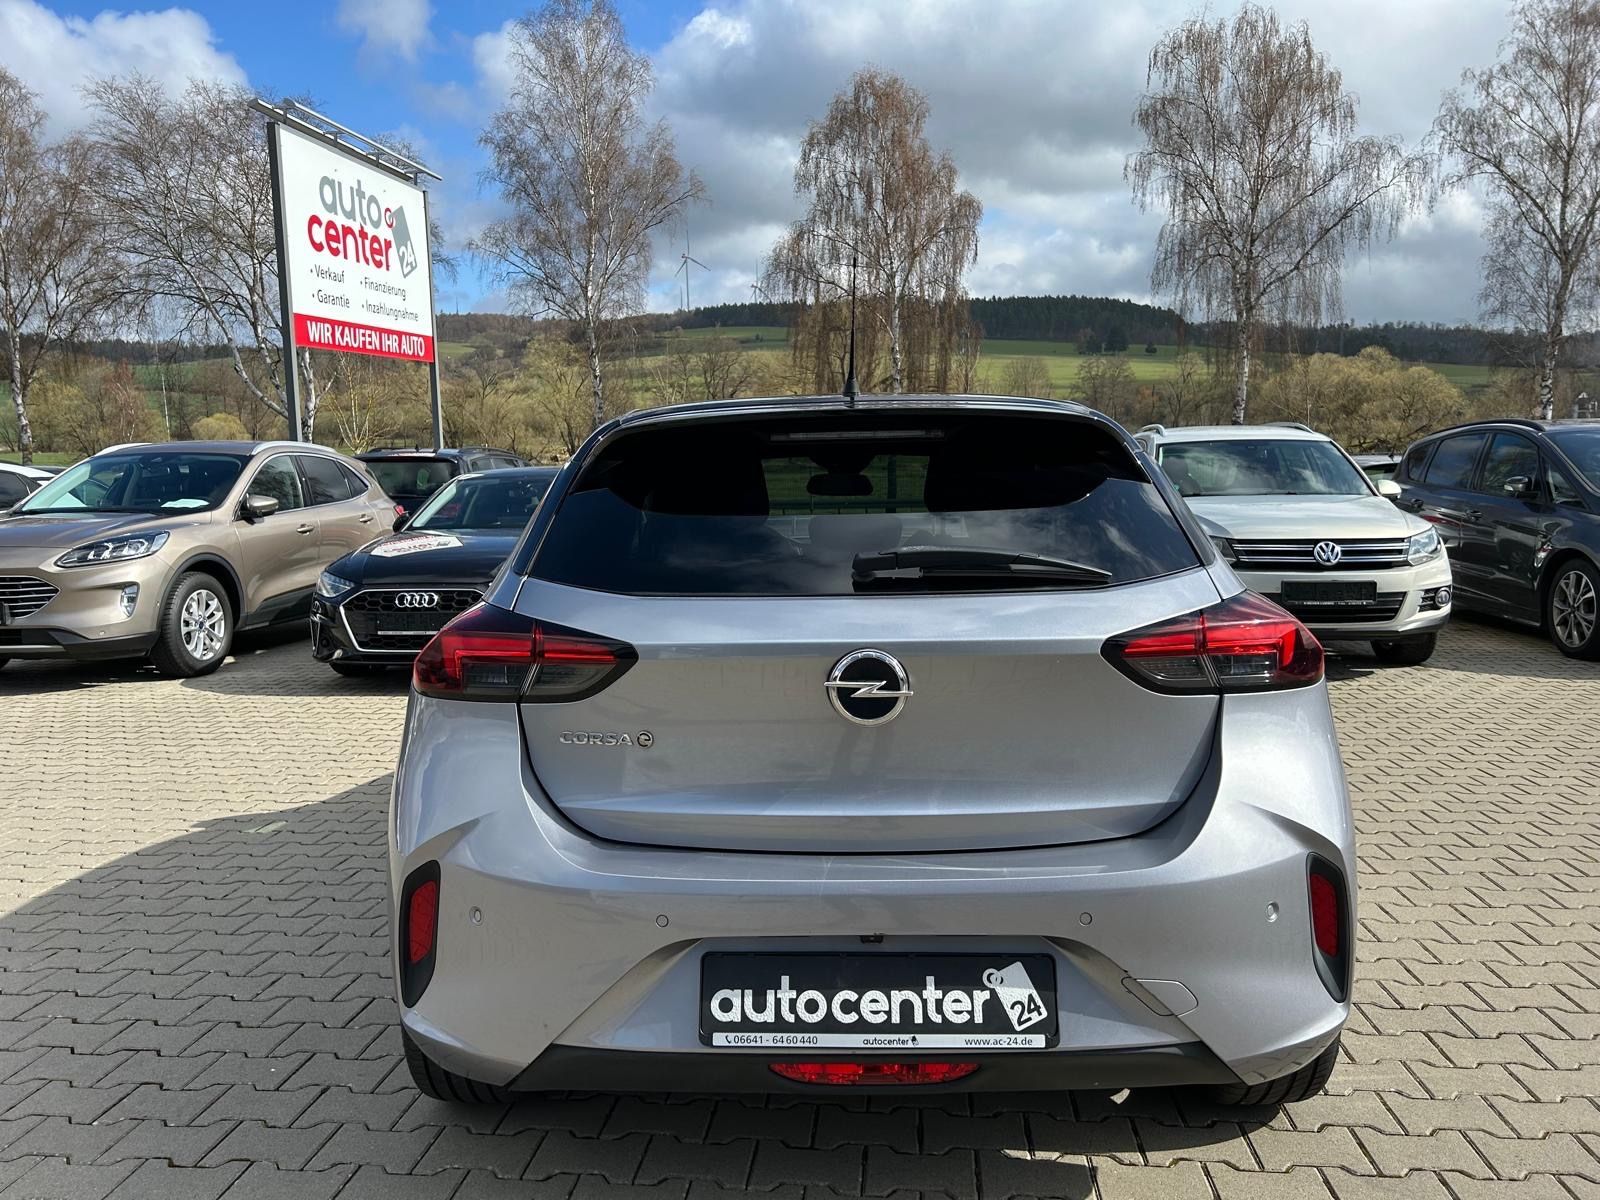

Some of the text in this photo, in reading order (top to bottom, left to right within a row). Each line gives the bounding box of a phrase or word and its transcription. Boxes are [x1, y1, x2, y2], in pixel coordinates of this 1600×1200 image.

[319, 176, 381, 229] auto
[308, 215, 391, 271] center
[399, 246, 414, 271] 24
[315, 264, 345, 283] Verkauf
[317, 289, 350, 308] Garantie
[364, 277, 406, 301] Finanzierung
[366, 299, 418, 321] Inzahlungnahme
[307, 320, 425, 356] WIR KAUFEN IHR AUTO
[560, 731, 634, 746] CORSA
[1010, 992, 1043, 1027] 24
[733, 1035, 764, 1045] 06641
[862, 1036, 909, 1046] autocenter
[964, 1036, 1033, 1046] www.ac-24.de
